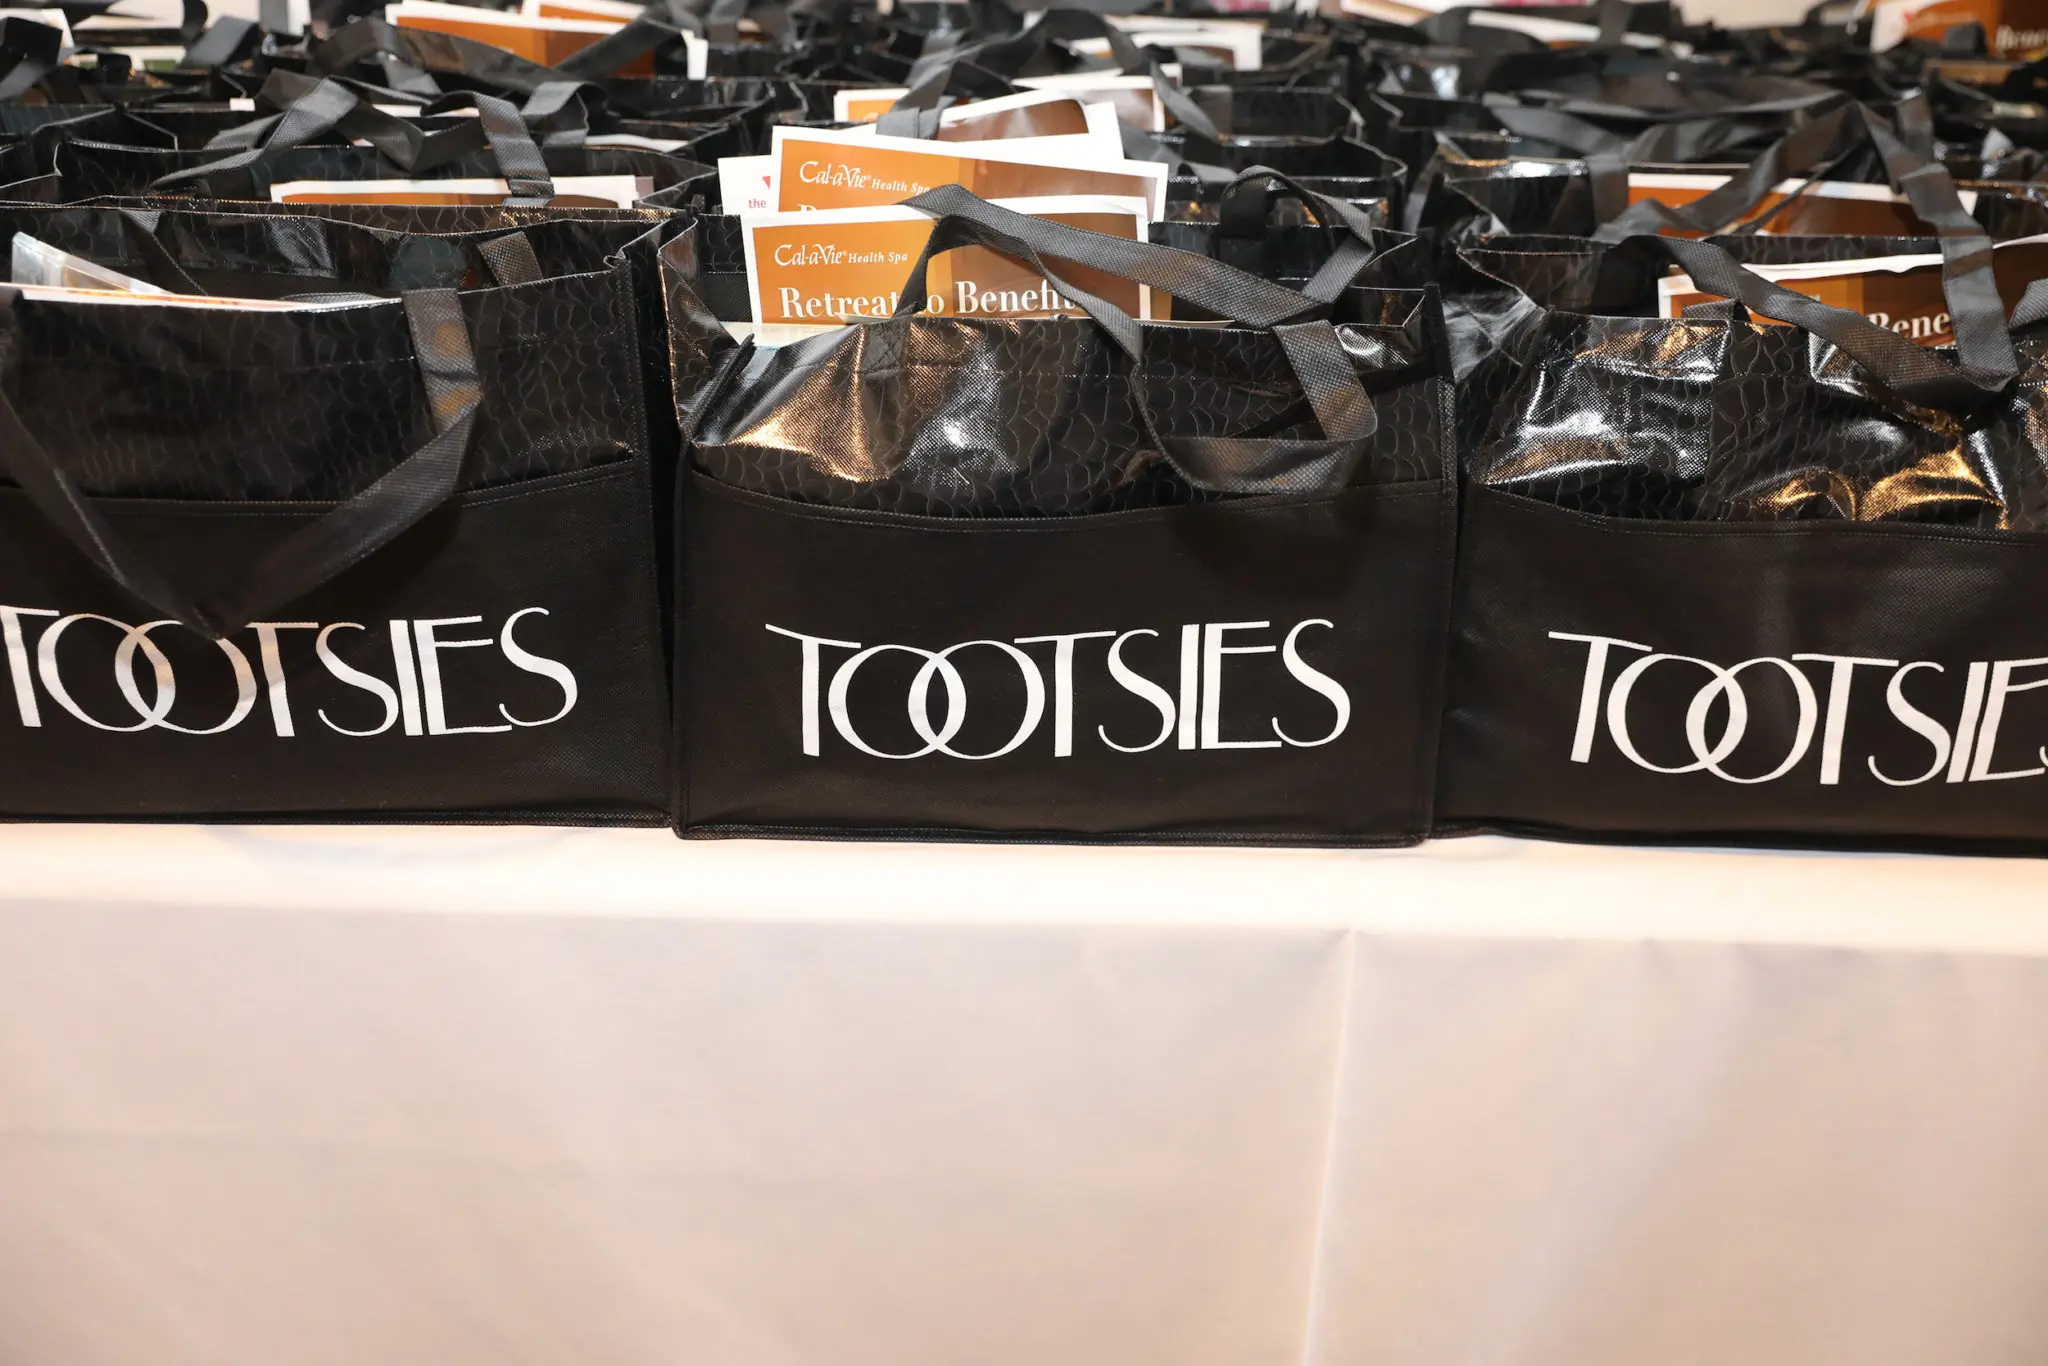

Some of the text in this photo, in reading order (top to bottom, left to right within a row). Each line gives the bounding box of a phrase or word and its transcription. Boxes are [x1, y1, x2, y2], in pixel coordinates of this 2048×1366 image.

[871, 178, 907, 193] Health
[748, 198, 767, 209] the
[848, 253, 885, 264] Health
[888, 252, 908, 265] Spa
[917, 294, 945, 315] o
[0, 606, 578, 737] TOOTSIES
[765, 618, 1351, 760] TOOTSIES
[1548, 631, 2048, 787] TOOTSIE
